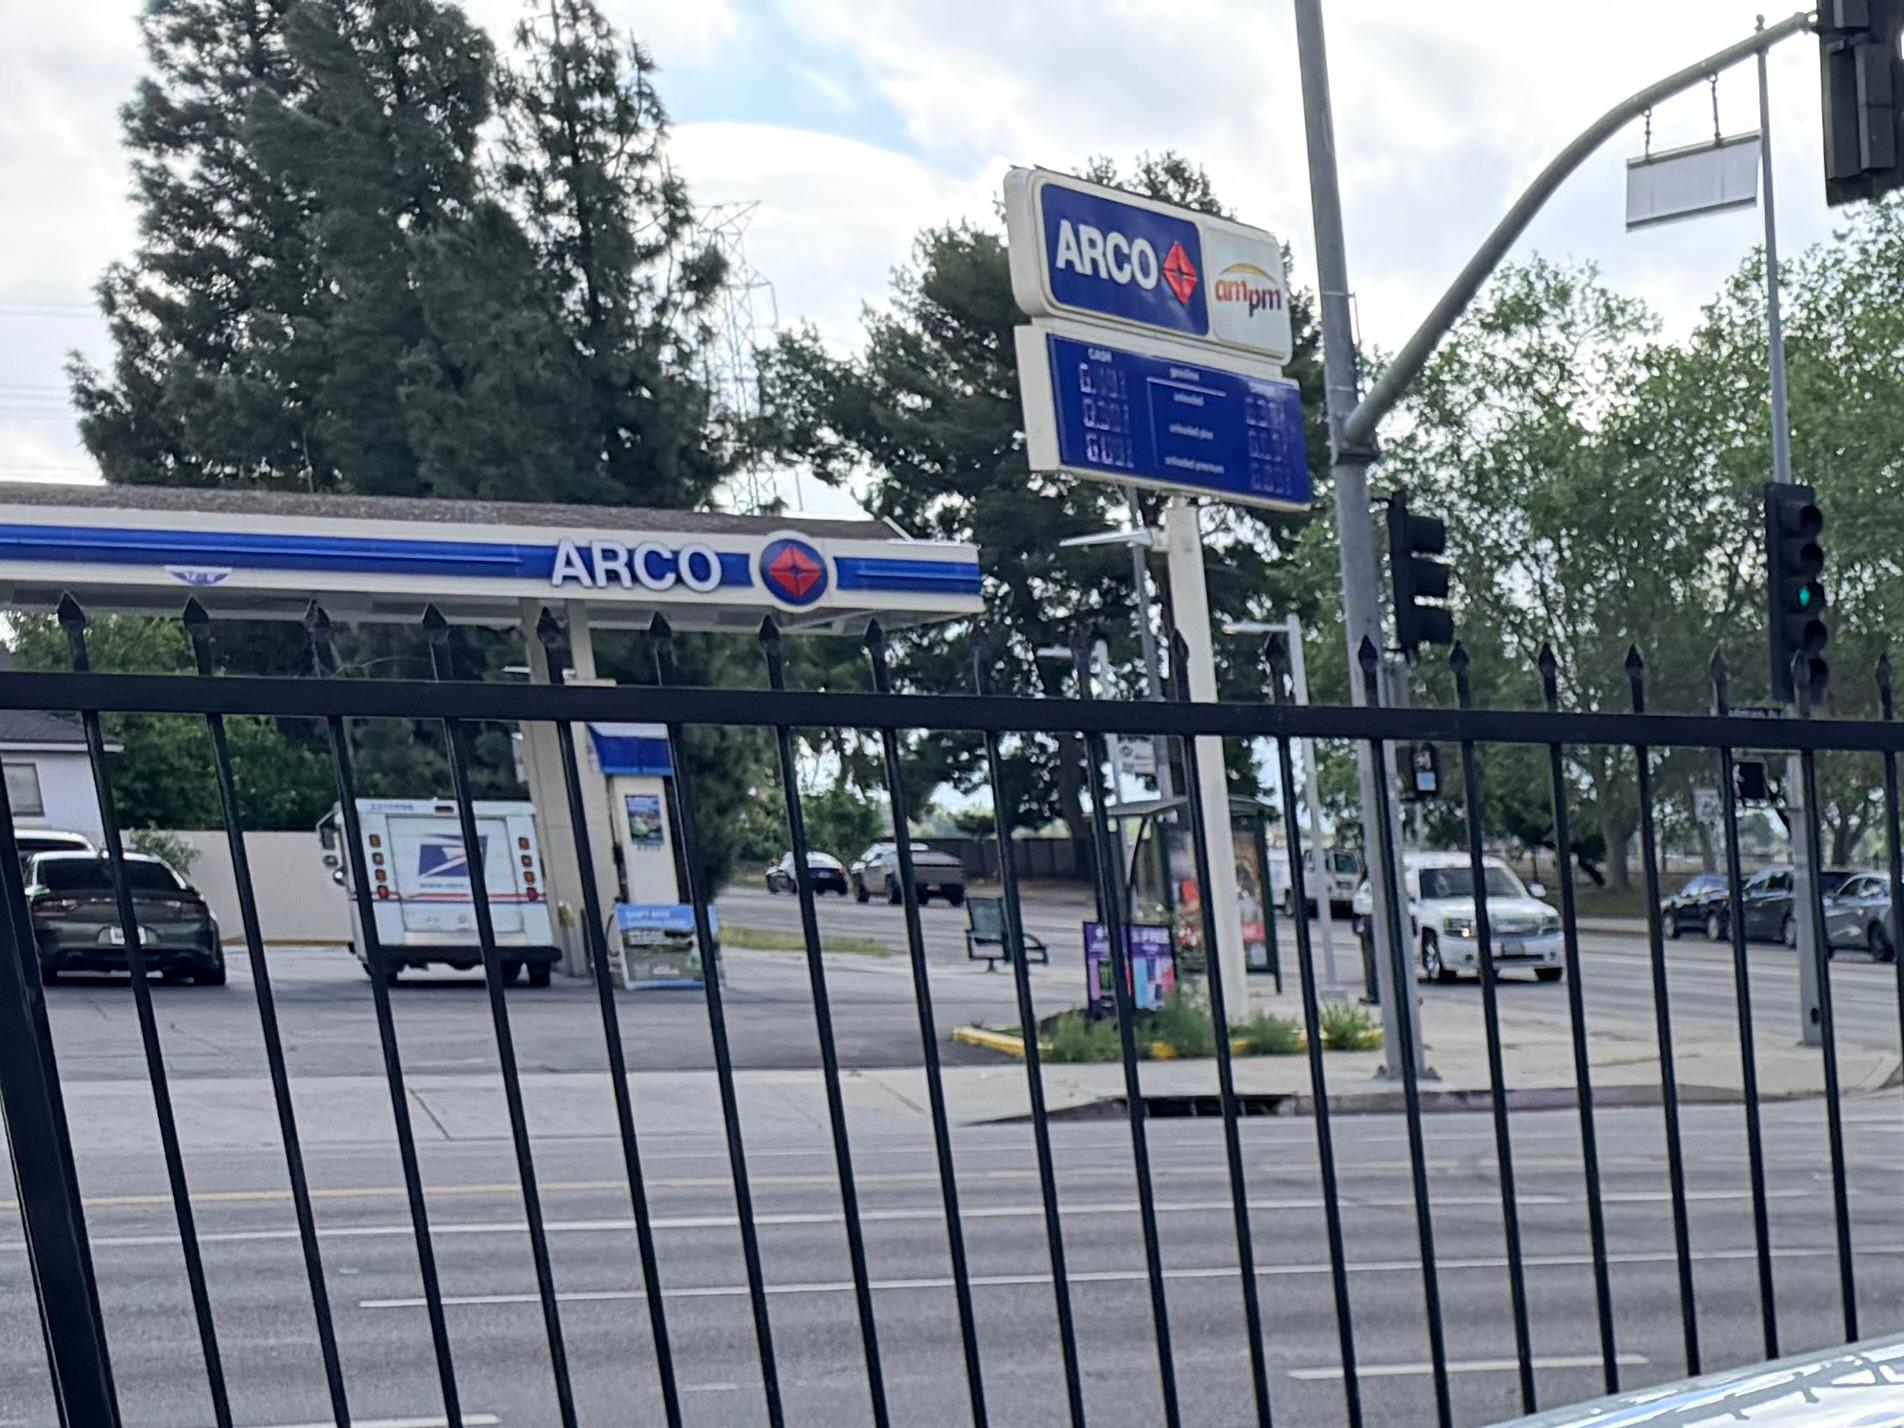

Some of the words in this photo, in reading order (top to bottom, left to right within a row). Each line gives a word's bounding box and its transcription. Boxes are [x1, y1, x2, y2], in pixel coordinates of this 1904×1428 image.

[1056, 219, 1158, 290] ARCO
[1215, 279, 1281, 317] ampm
[551, 539, 722, 593] ARCO
